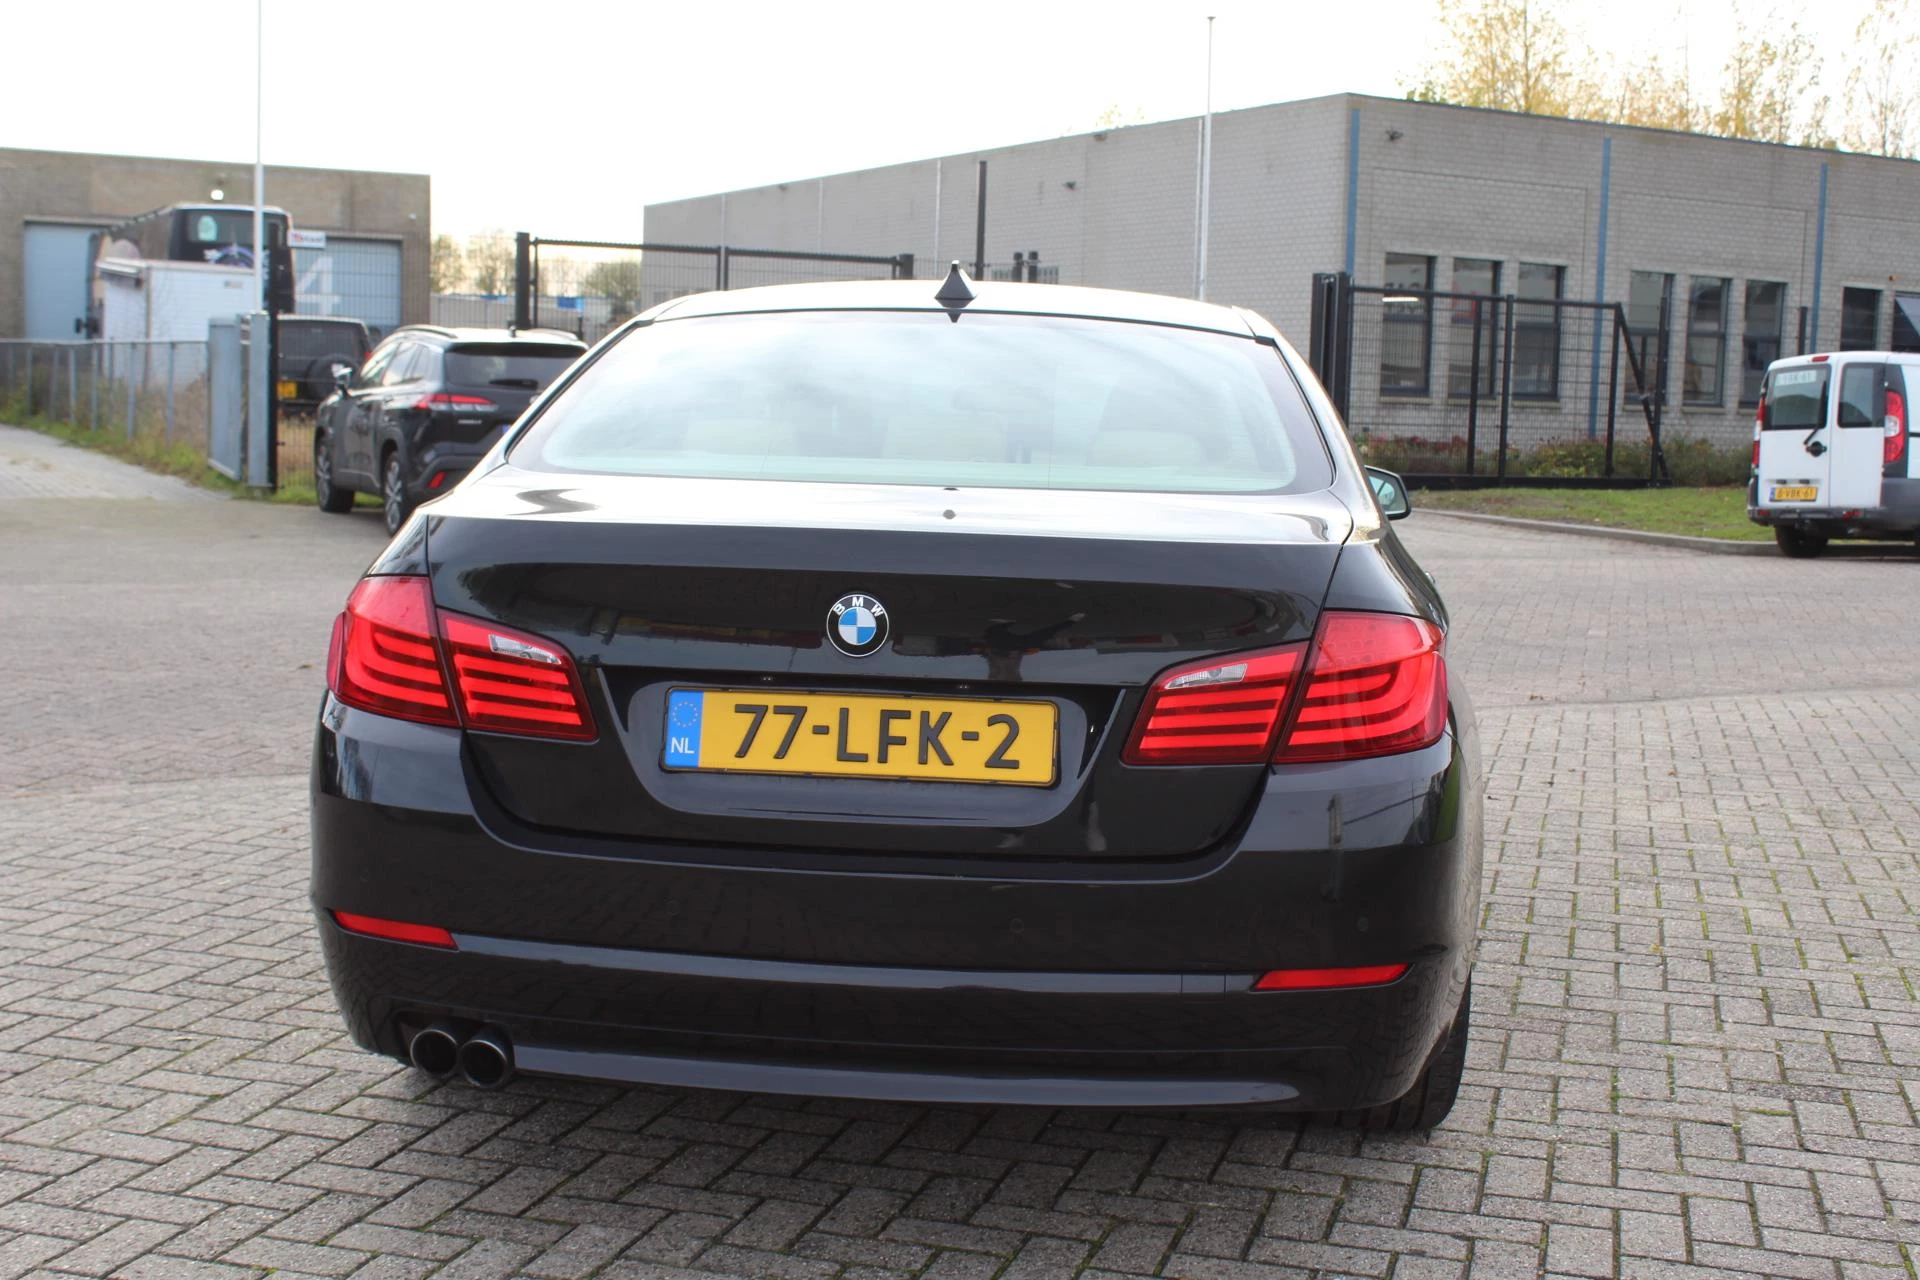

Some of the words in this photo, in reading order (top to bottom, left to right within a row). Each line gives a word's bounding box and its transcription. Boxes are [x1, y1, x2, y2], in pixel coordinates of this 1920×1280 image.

[833, 596, 884, 617] BMW
[670, 736, 695, 754] NL
[734, 703, 1020, 769] 77-LFK-2
